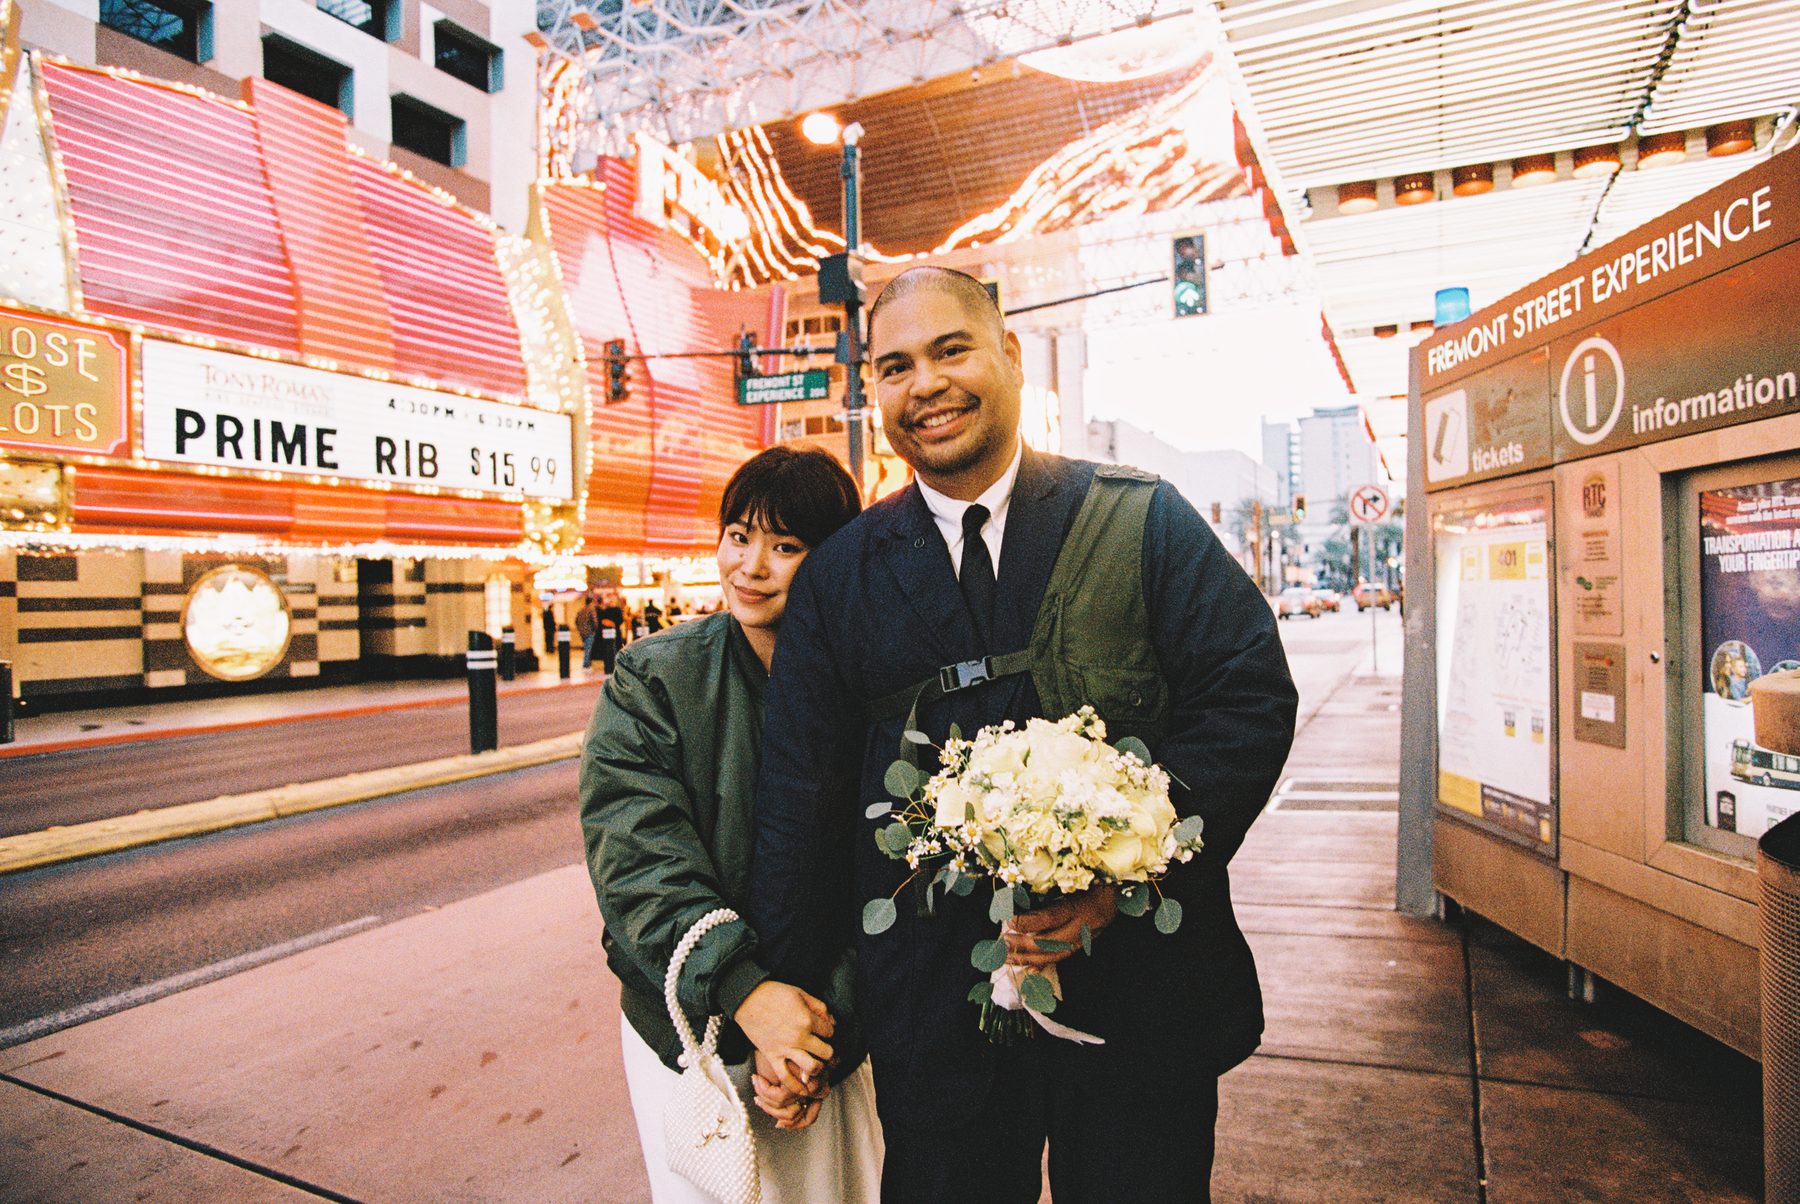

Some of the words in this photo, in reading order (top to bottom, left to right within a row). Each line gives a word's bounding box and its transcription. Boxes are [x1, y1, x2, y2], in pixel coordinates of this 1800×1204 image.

[1428, 314, 1508, 376] FREMONT
[1513, 276, 1585, 339] STREET
[1591, 186, 1772, 303] EXPERIENCE
[0, 326, 98, 382] OSE
[746, 375, 791, 390] FREMONT
[746, 387, 805, 404] EXPERIENCE
[1632, 369, 1797, 434] information
[175, 407, 338, 470] PRIME
[375, 435, 438, 478] RIB
[1471, 440, 1524, 474] tickets
[1582, 483, 1606, 510] RTC
[1703, 529, 1792, 556] TRANSPORTATION
[1718, 553, 1747, 573] YOUR
